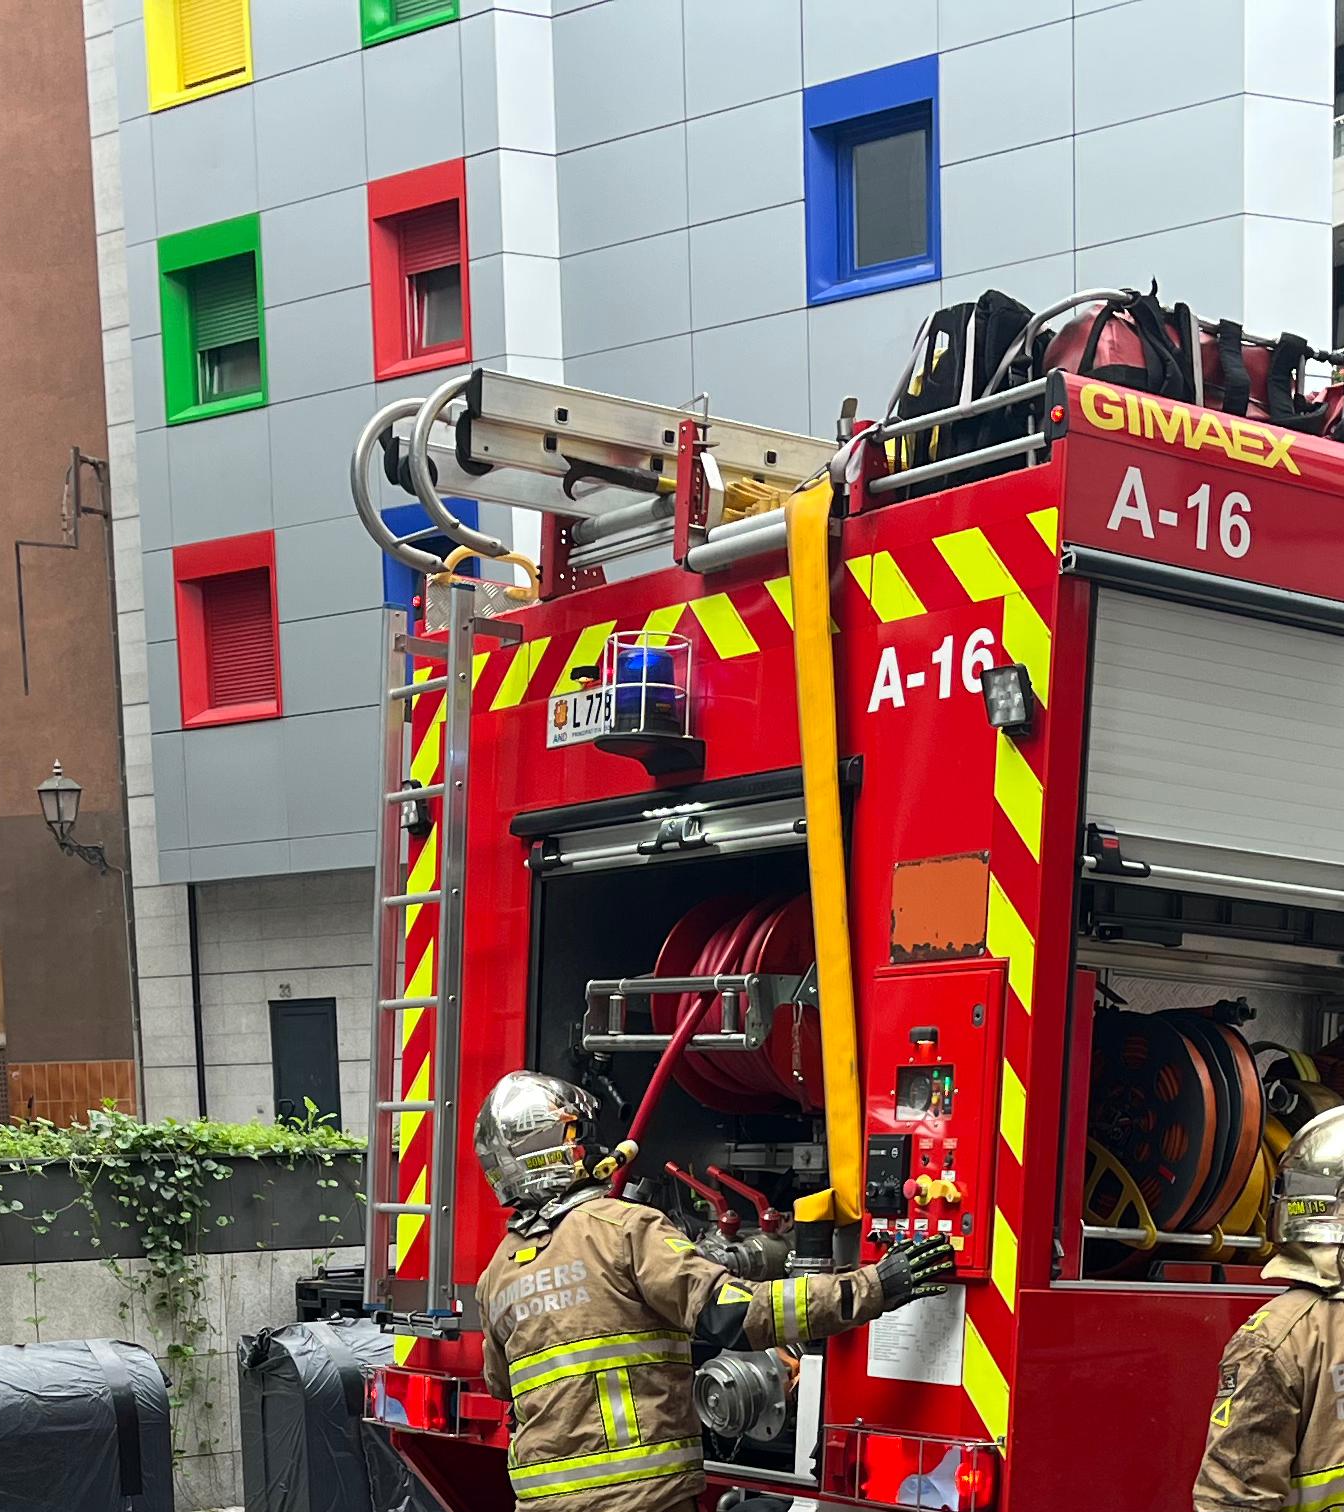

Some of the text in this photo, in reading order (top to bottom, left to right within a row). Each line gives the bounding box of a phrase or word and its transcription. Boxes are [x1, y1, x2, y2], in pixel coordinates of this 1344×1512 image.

[1080, 383, 1301, 476] GIMAEX
[1106, 465, 1252, 559] A-16
[867, 627, 995, 714] A-16
[552, 732, 567, 744] AND
[572, 697, 581, 729] L
[1287, 1200, 1326, 1216] BOM 115
